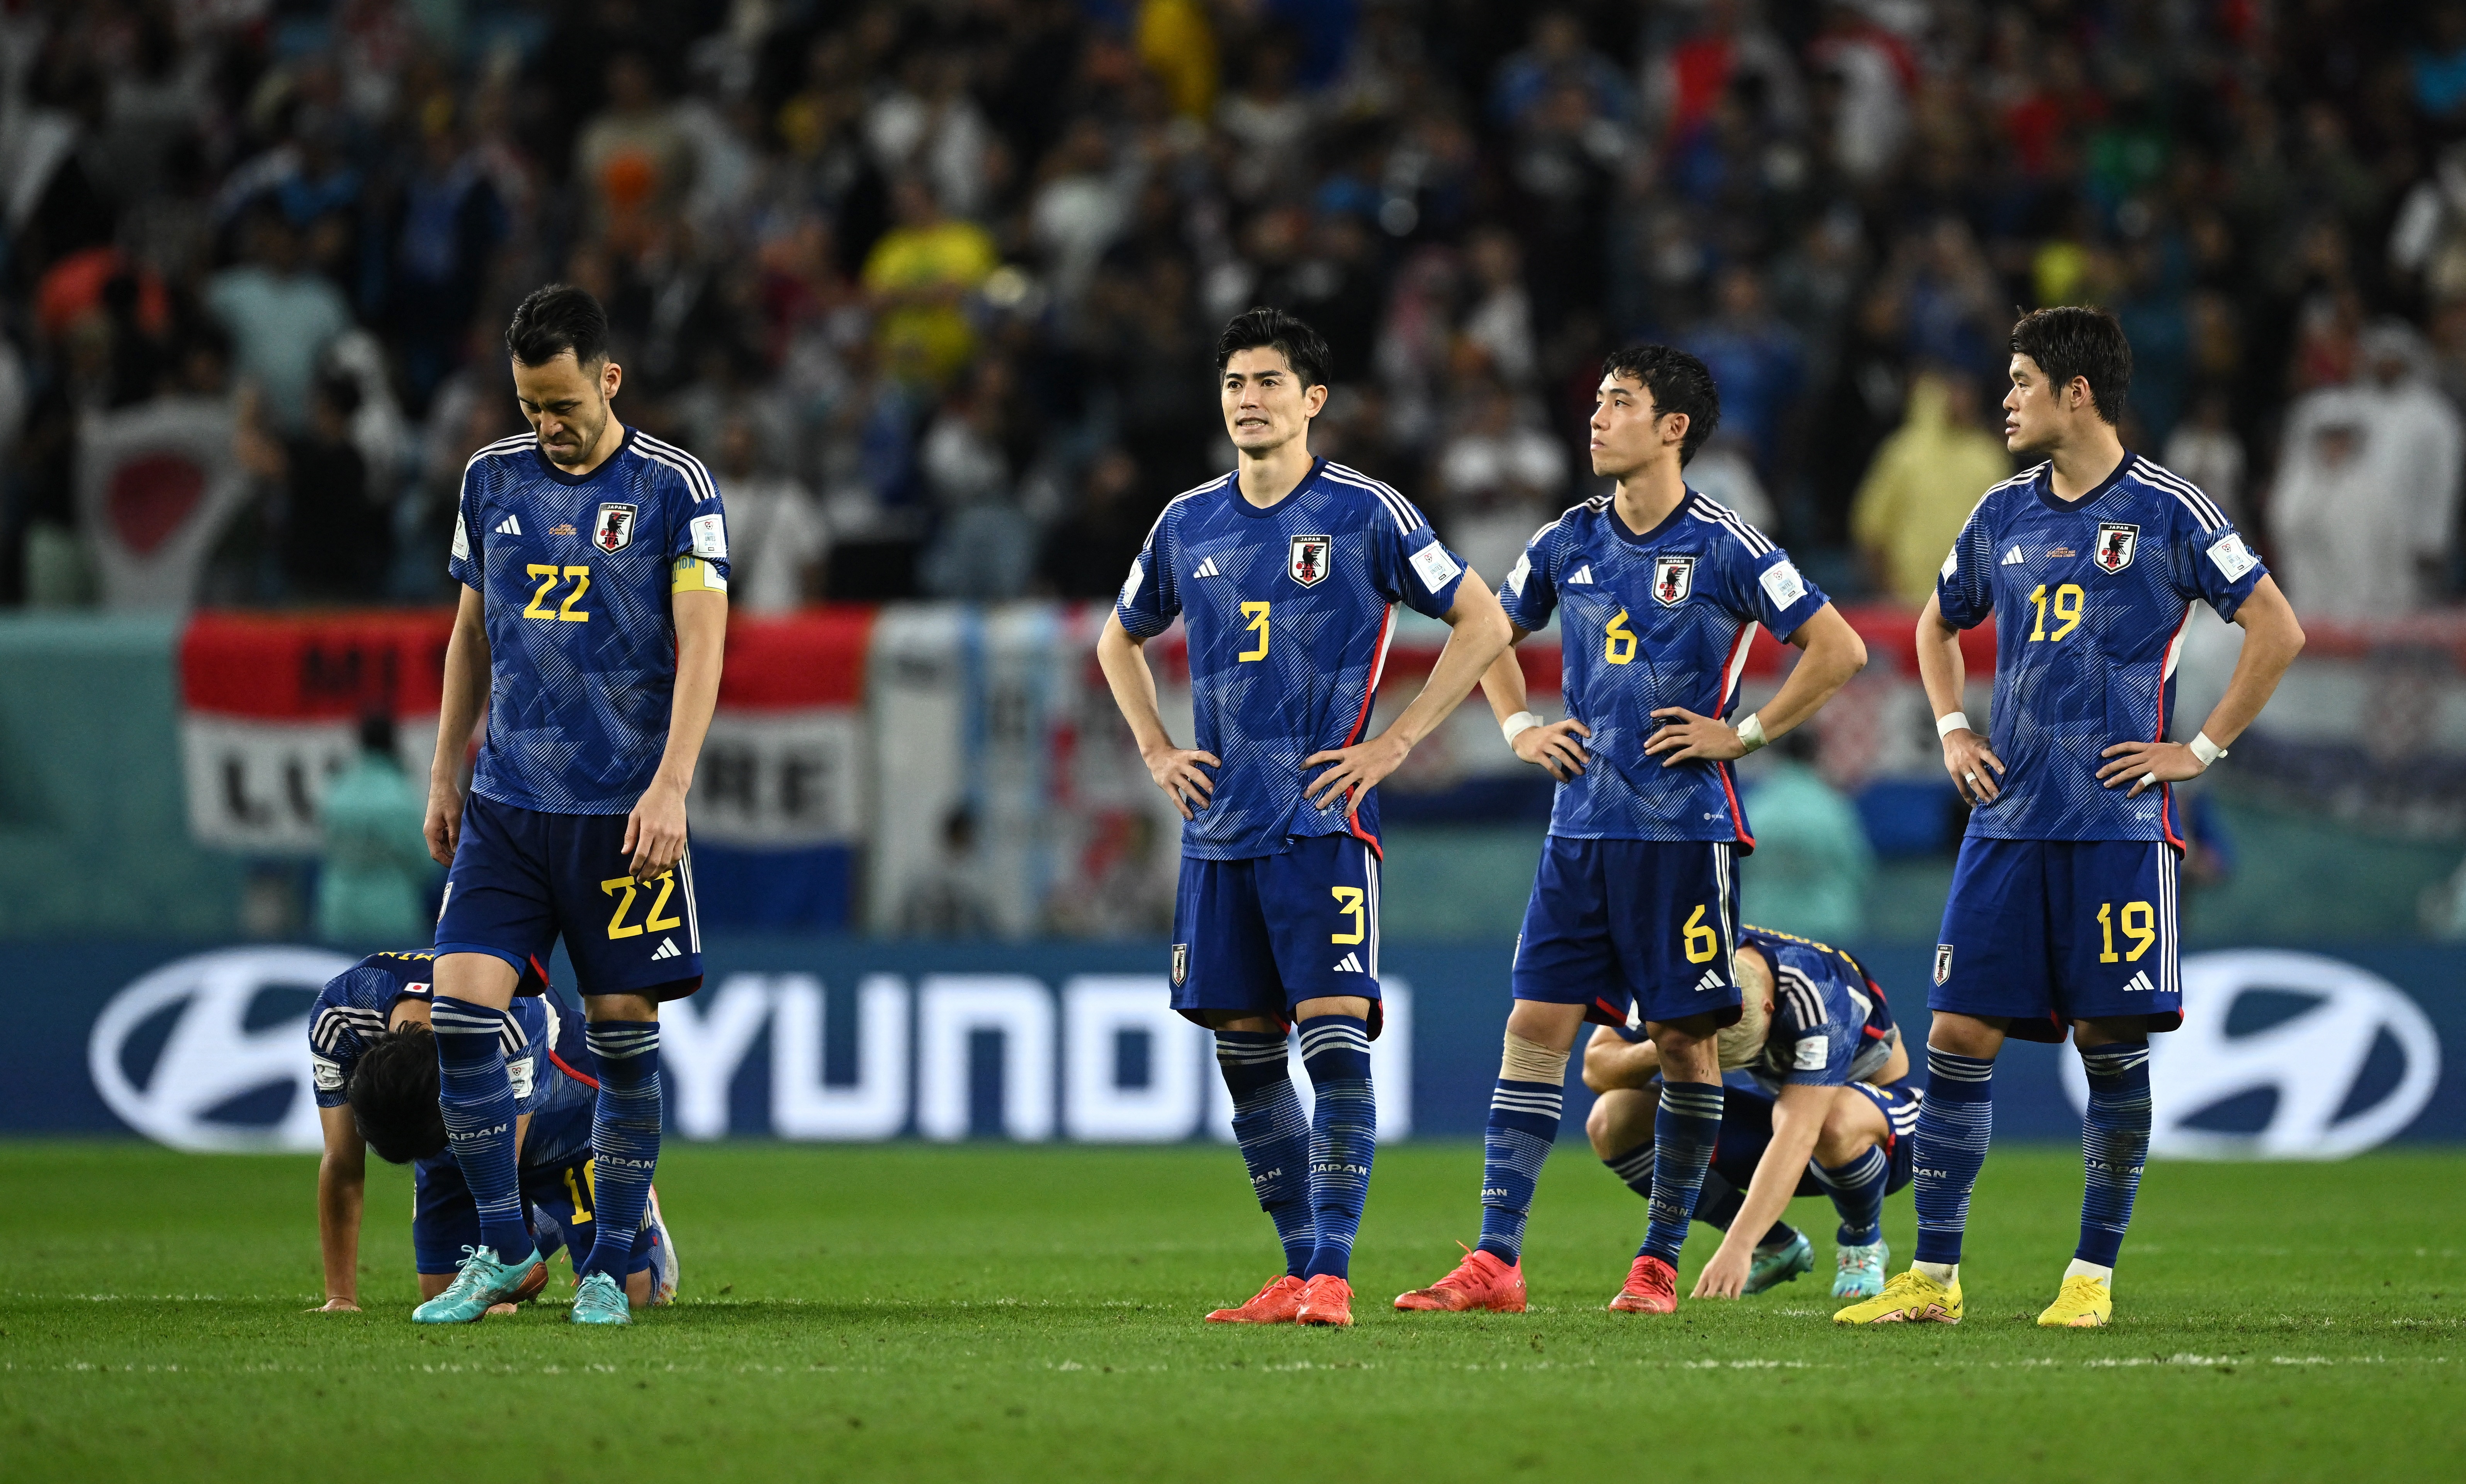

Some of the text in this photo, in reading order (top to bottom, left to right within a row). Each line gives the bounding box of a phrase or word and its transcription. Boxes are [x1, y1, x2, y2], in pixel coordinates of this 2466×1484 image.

[602, 537, 619, 545] JFA
[1430, 565, 1442, 574] UNITES
[2104, 556, 2121, 565] JFA
[524, 564, 589, 622] 22
[1780, 581, 1793, 592] UNITES
[2030, 584, 2084, 641] 19
[1239, 602, 1270, 662] 3
[1605, 609, 1637, 664] 6
[601, 870, 680, 940] 22
[1332, 886, 1364, 945] 3
[1683, 904, 1717, 963] 6
[2097, 901, 2155, 963] 19
[658, 972, 1413, 1141] YUNDI
[446, 1123, 506, 1140] APAN
[1250, 1168, 1282, 1185] PAN
[1310, 1164, 1367, 1175] JAPAN
[1913, 1165, 1946, 1178] PAN
[1481, 1188, 1507, 1197] PAN
[1649, 1198, 1688, 1216] APAN
